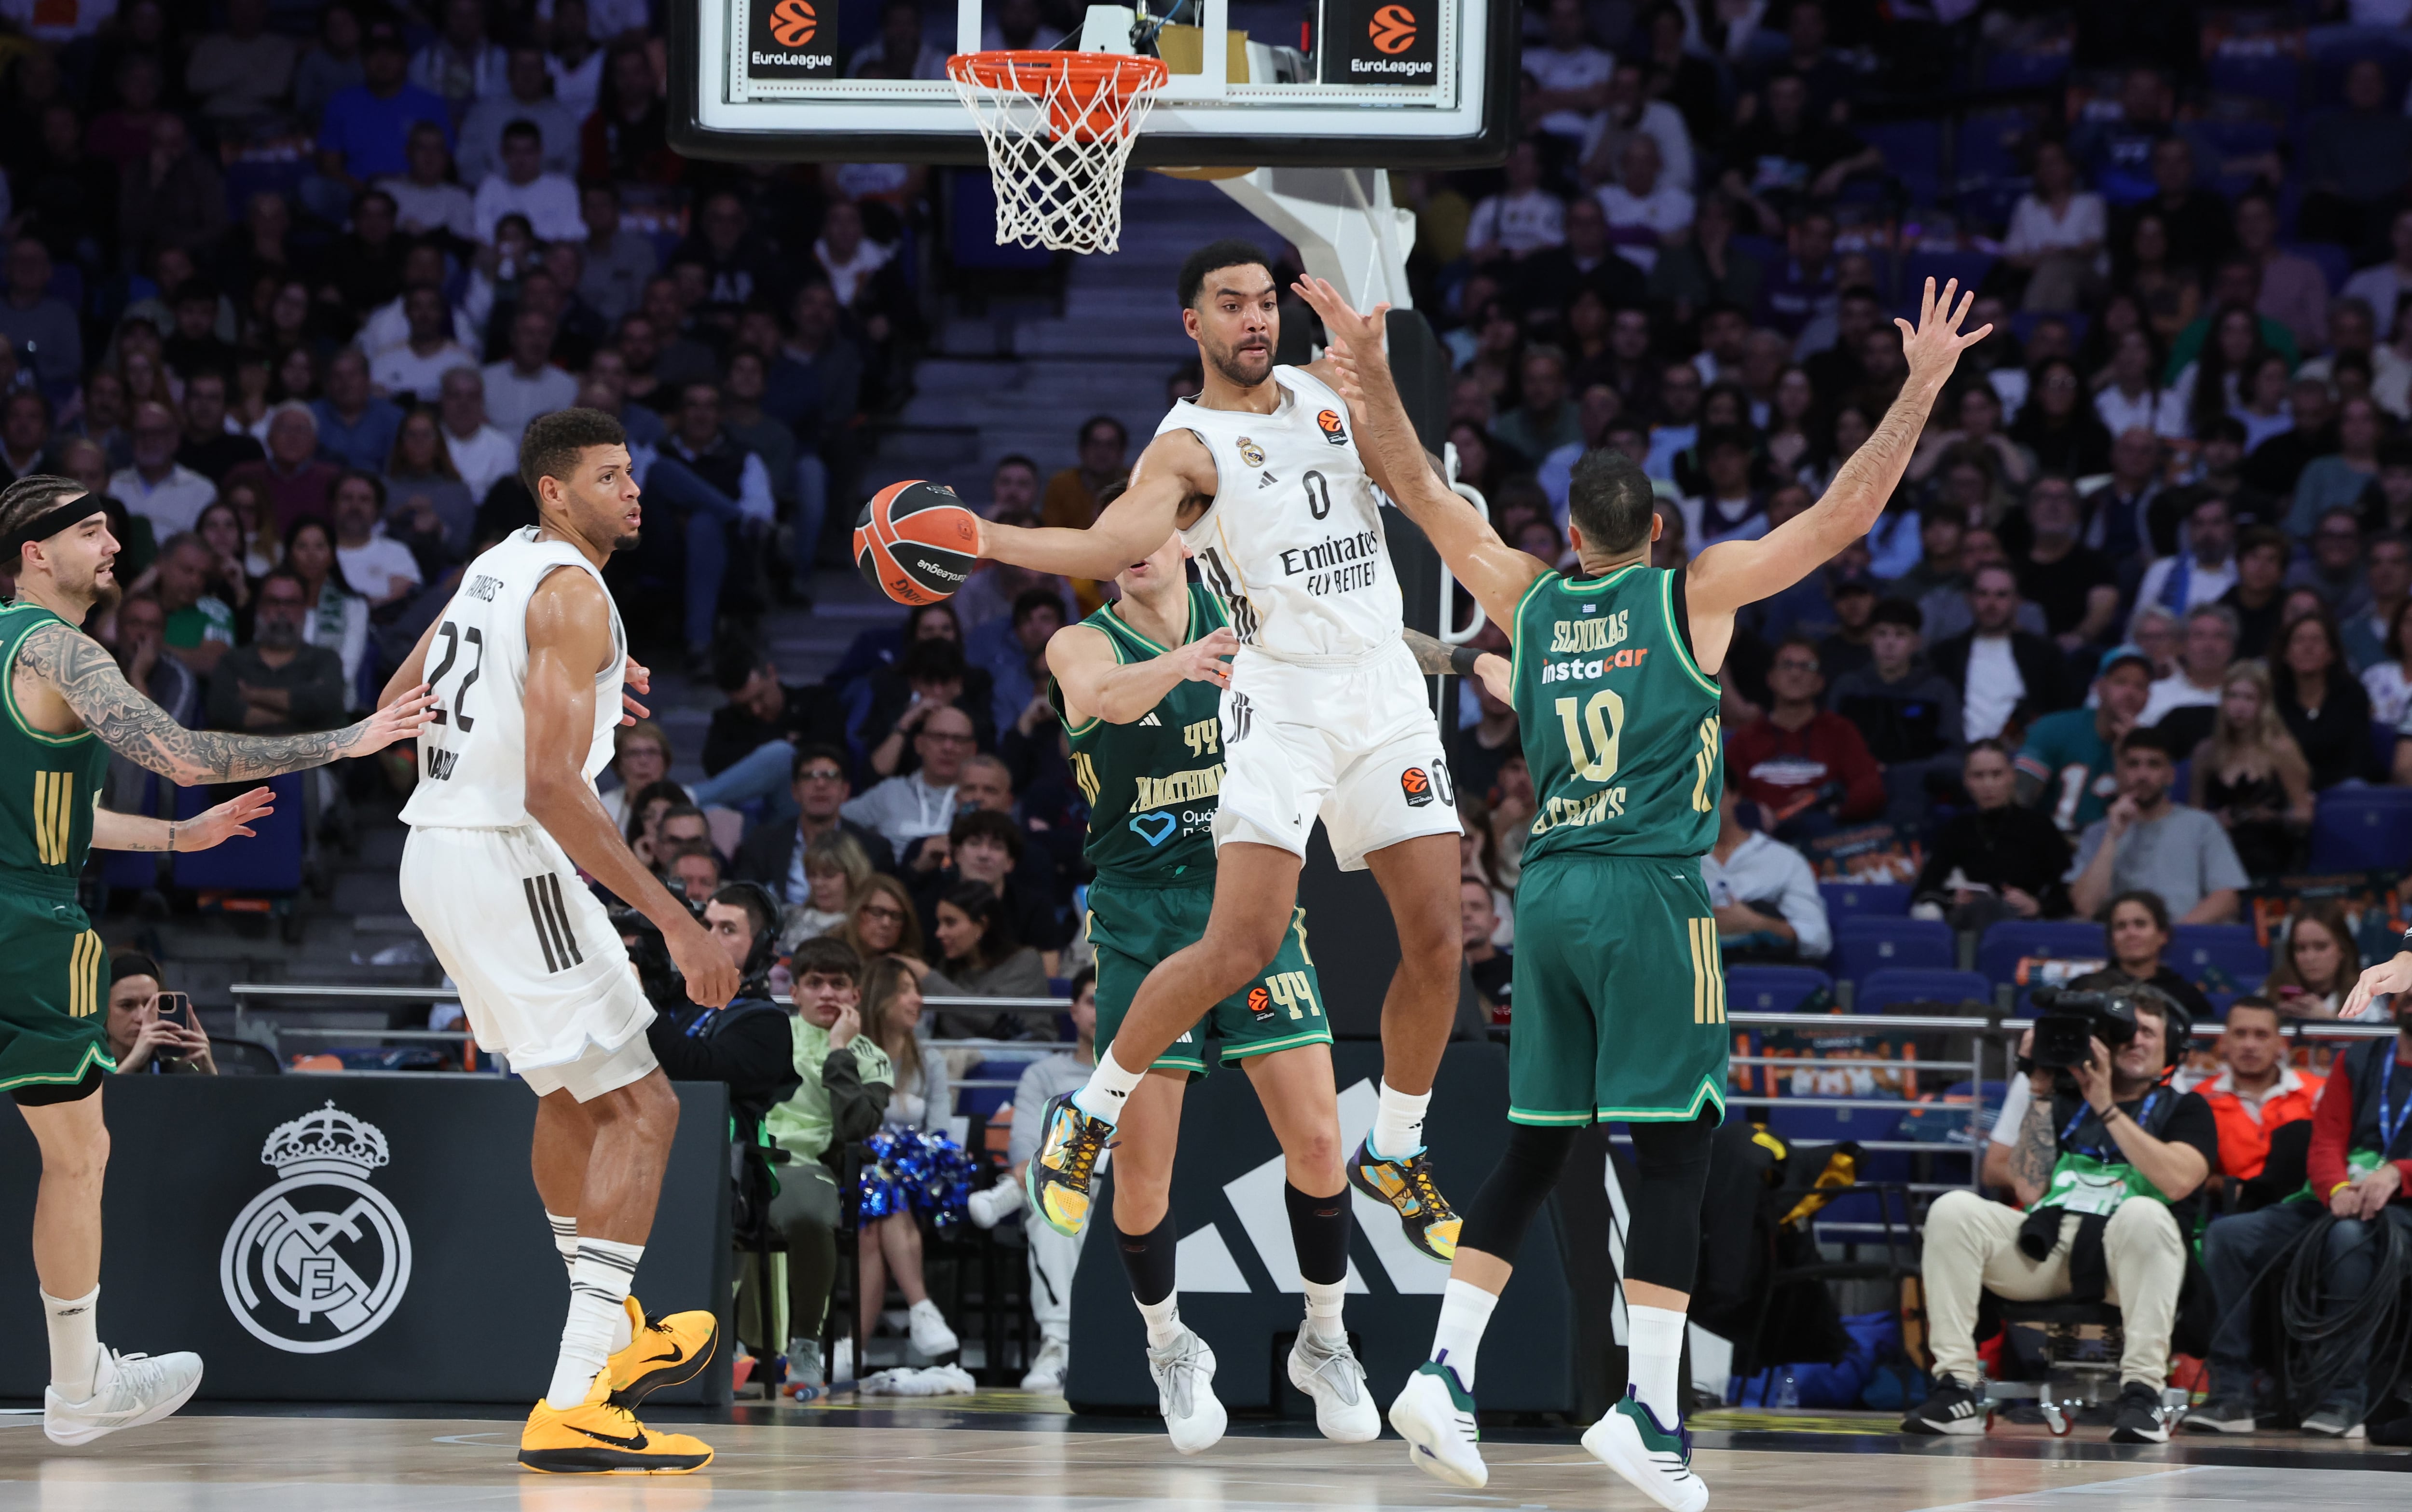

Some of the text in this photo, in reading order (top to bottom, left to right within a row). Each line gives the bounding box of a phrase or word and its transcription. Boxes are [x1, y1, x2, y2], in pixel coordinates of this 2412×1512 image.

[752, 51, 832, 69] EuroLeague
[1351, 58, 1433, 77] EuroLeague
[1302, 470, 1330, 520] 0
[1279, 530, 1377, 576] Emirates
[1307, 572, 1330, 596] FLY
[1550, 609, 1629, 654] SLOUKAS
[424, 621, 482, 733] 22
[1542, 648, 1648, 684] instacar
[1183, 717, 1218, 758] 44
[1555, 689, 1624, 782] 10
[1432, 758, 1453, 807] 0
[1183, 807, 1219, 825] Ομά
[1265, 970, 1320, 1020] 44
